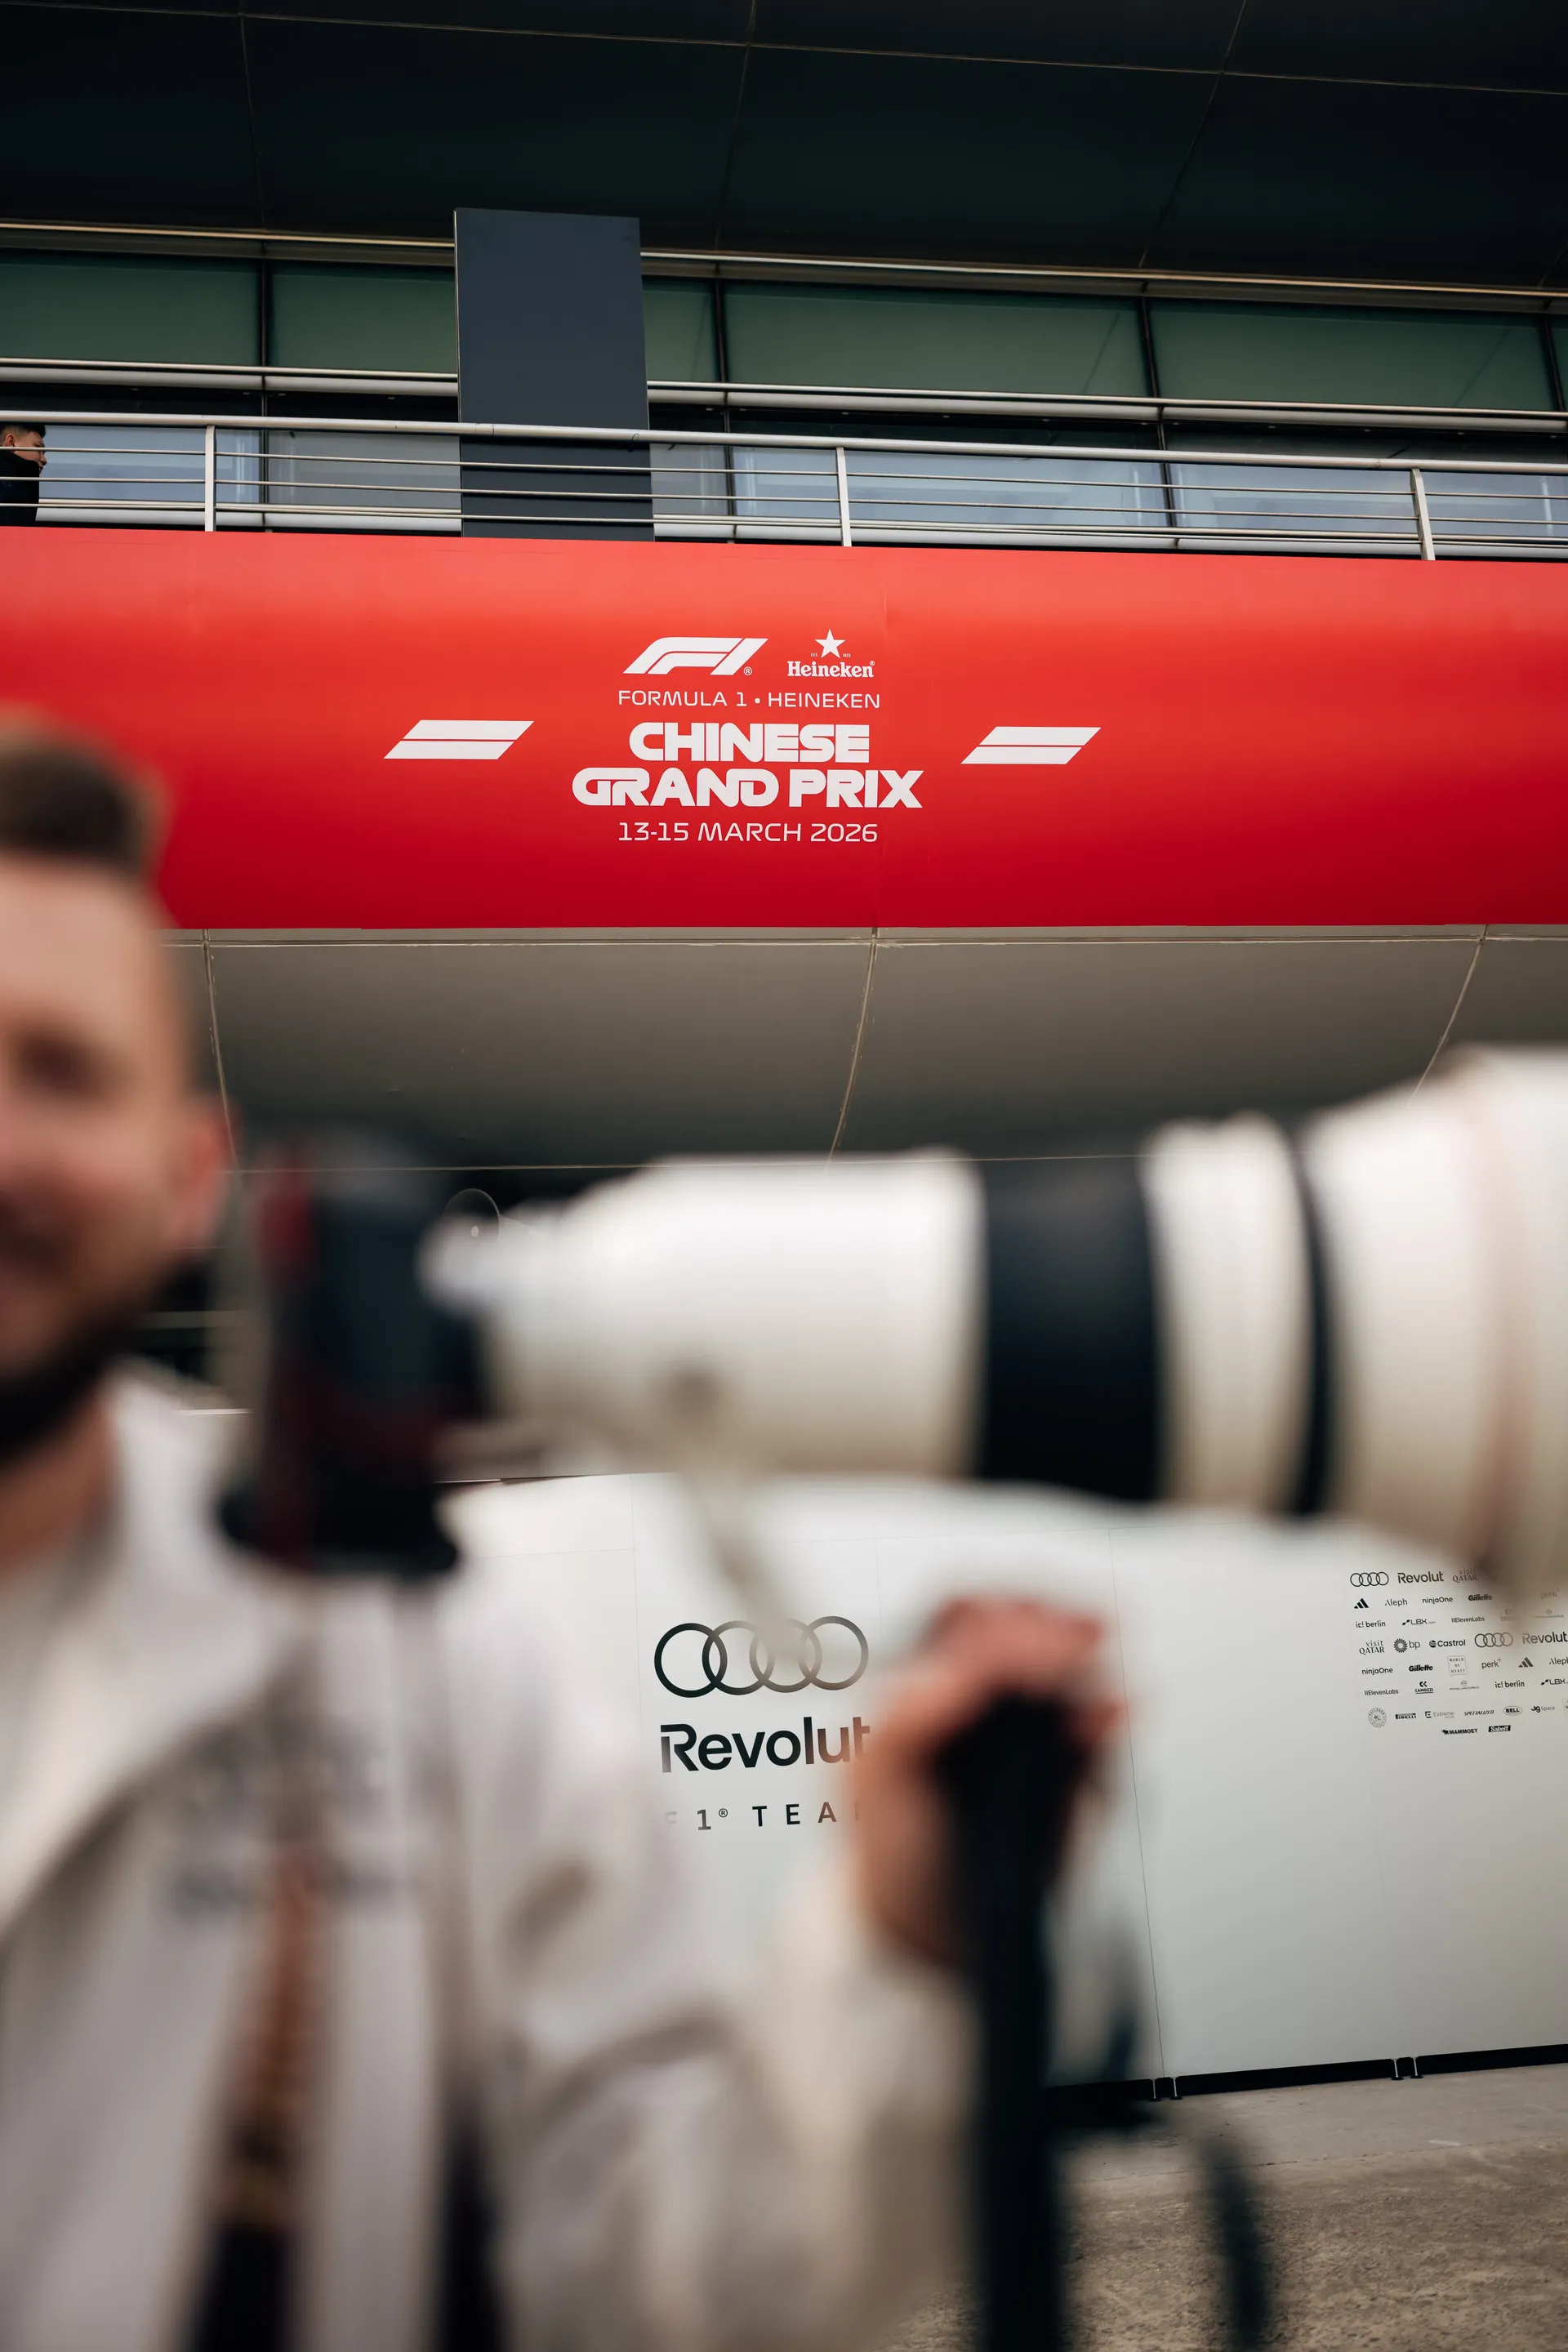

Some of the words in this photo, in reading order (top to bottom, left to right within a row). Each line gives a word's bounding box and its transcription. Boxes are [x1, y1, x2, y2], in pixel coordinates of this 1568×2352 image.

[618, 690, 728, 706] FORMULA
[736, 692, 747, 706] 1
[768, 692, 880, 709] HEINEKEN
[629, 722, 870, 763] CHINESE
[572, 767, 780, 808] GRAND
[788, 768, 924, 808] PRIX
[618, 822, 690, 842] 13-15
[697, 822, 802, 842] MARCH
[810, 822, 878, 843] 2026
[1397, 1571, 1444, 1584] Revolut
[1452, 1575, 1478, 1584] QATAR
[1365, 1619, 1386, 1628] berlin
[1408, 1640, 1421, 1650] bp
[1437, 1639, 1466, 1647] Castrol
[1521, 1632, 1568, 1645] Revolut
[1359, 1646, 1385, 1655] QATAR
[1504, 1680, 1526, 1688] berlin
[660, 1717, 871, 1773] Revolut
